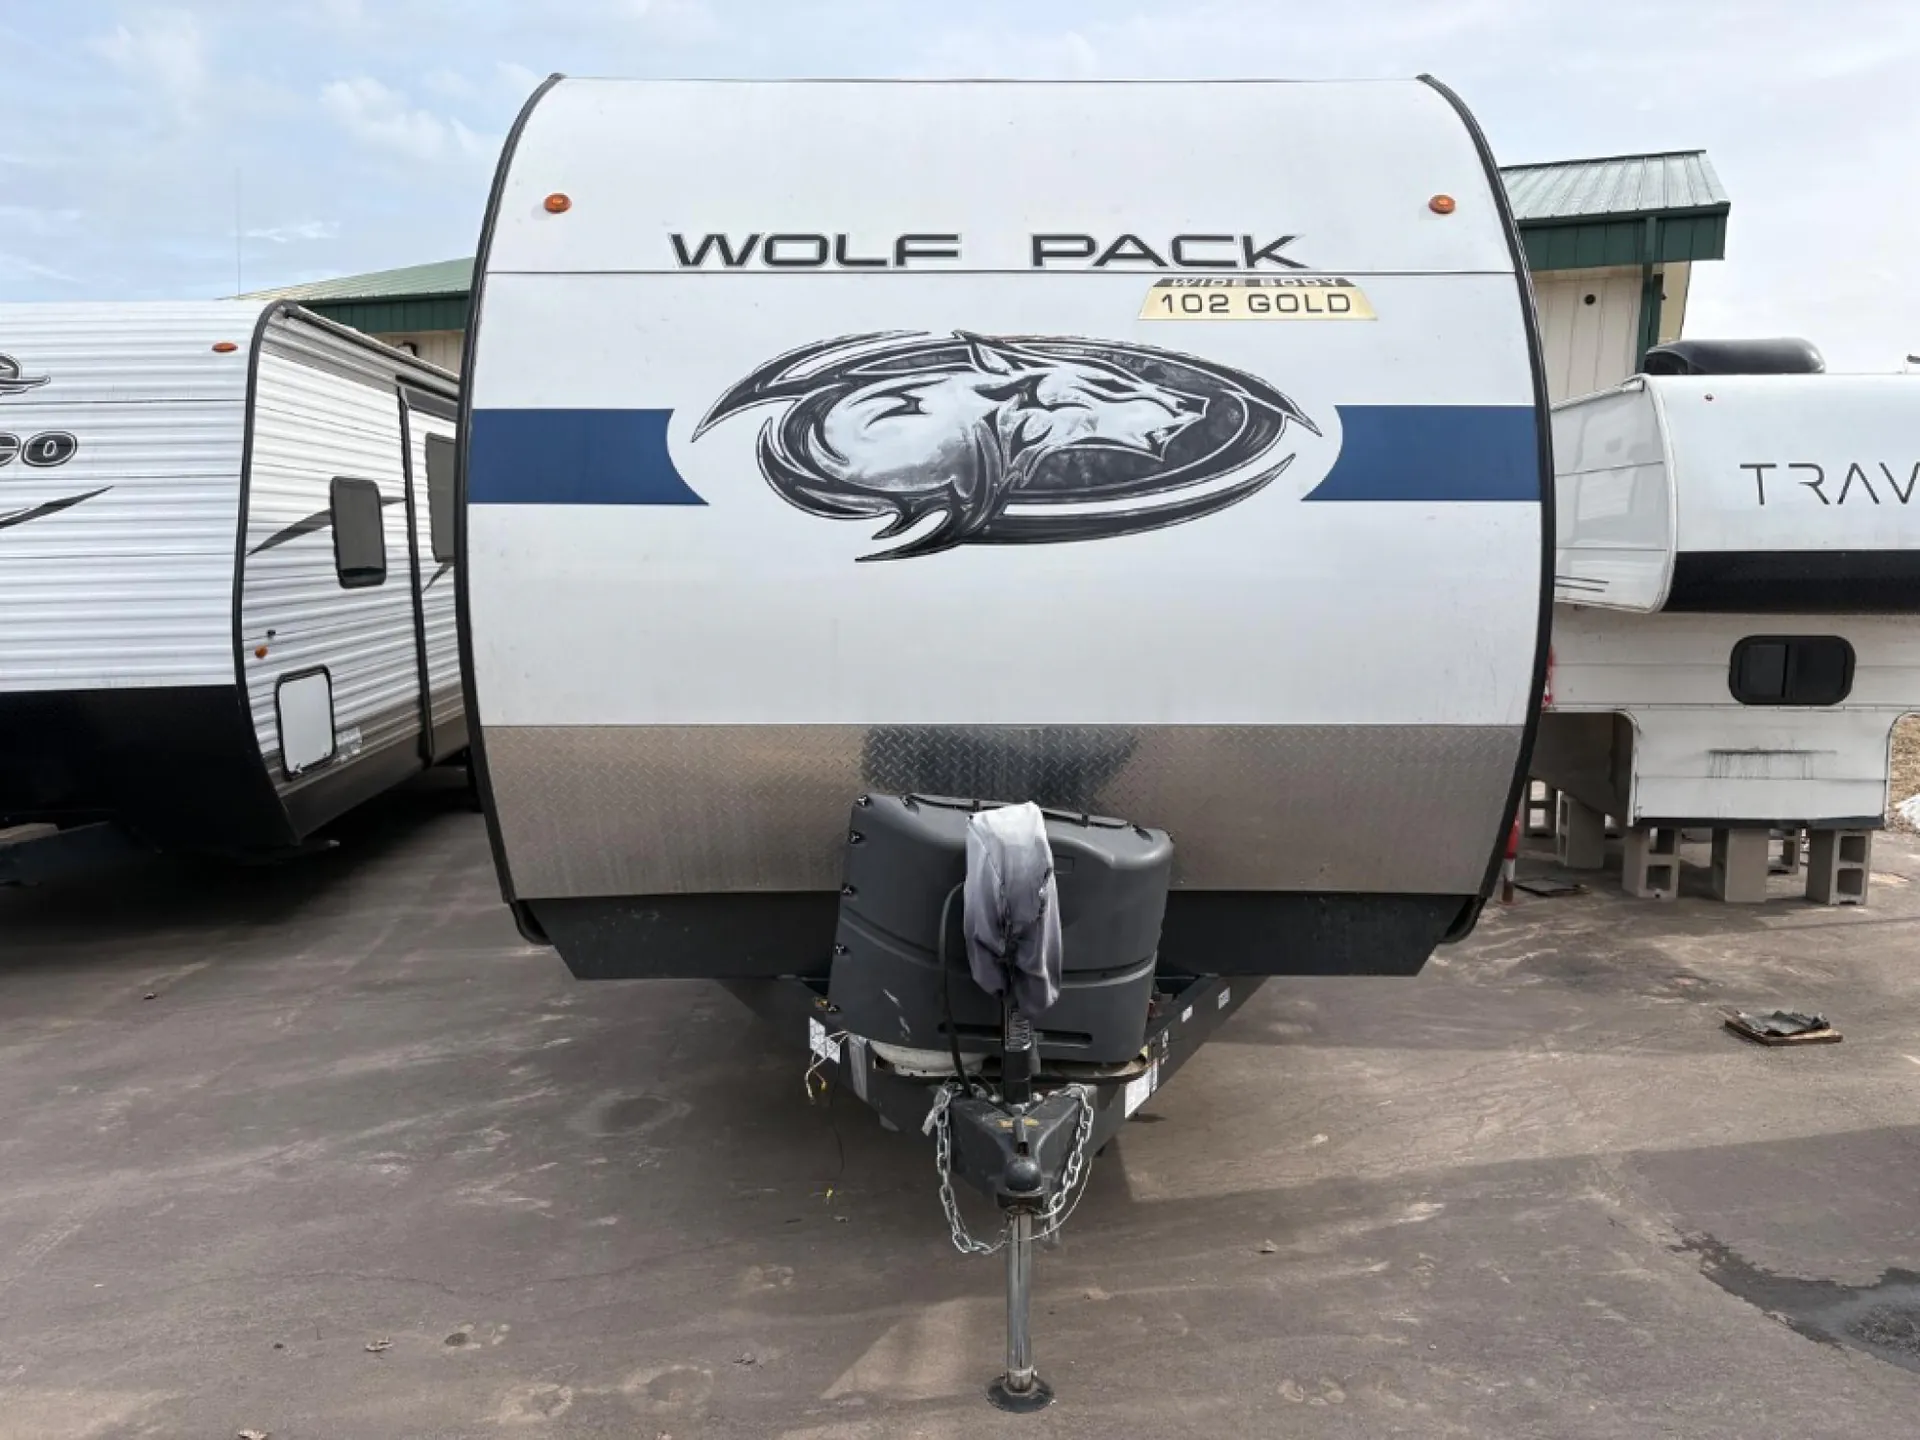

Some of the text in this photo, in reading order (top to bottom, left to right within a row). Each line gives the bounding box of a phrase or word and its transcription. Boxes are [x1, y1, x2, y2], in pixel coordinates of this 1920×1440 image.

[669, 232, 1310, 269] WOLF PACK
[1161, 293, 1352, 314] 102 GOLD
[1739, 461, 1920, 506] TRAV
